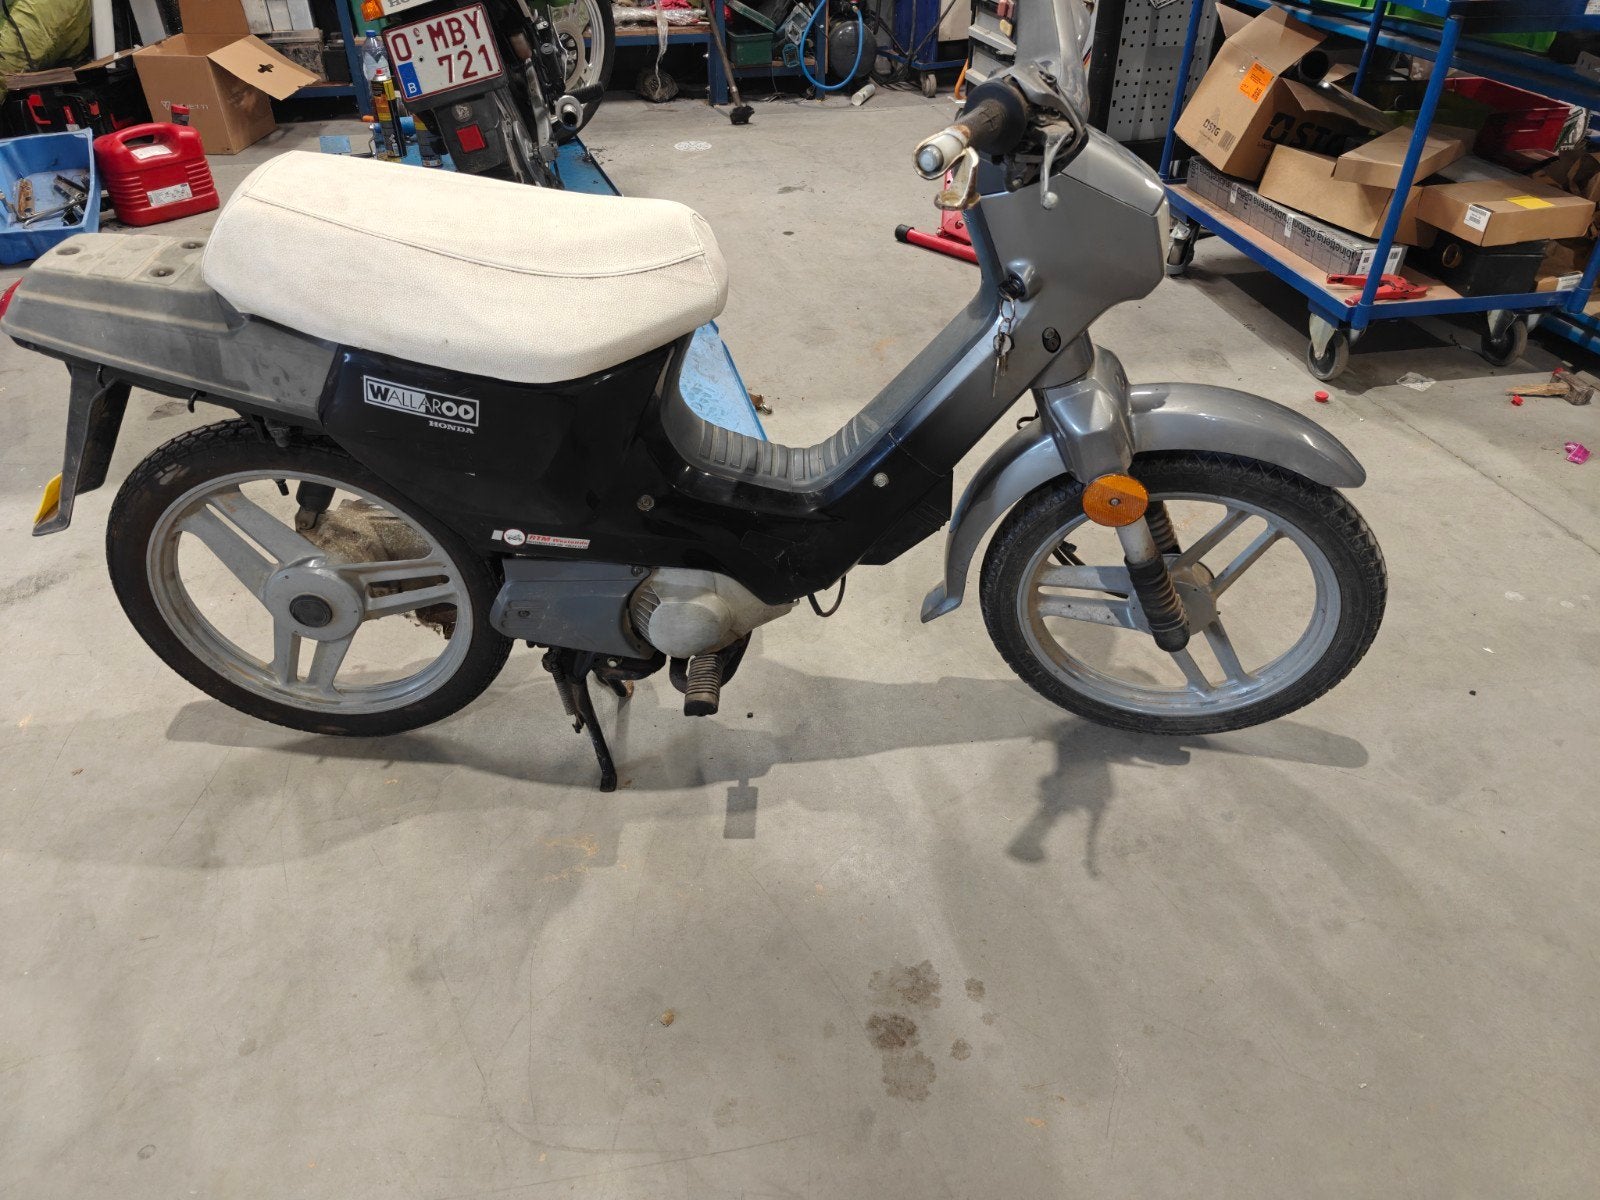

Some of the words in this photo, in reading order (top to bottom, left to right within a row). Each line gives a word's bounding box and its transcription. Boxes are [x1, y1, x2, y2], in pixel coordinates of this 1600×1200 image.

[437, 44, 493, 83] 721
[407, 82, 417, 93] B
[369, 384, 475, 420] WALLAROO
[429, 421, 475, 434] HONDA
